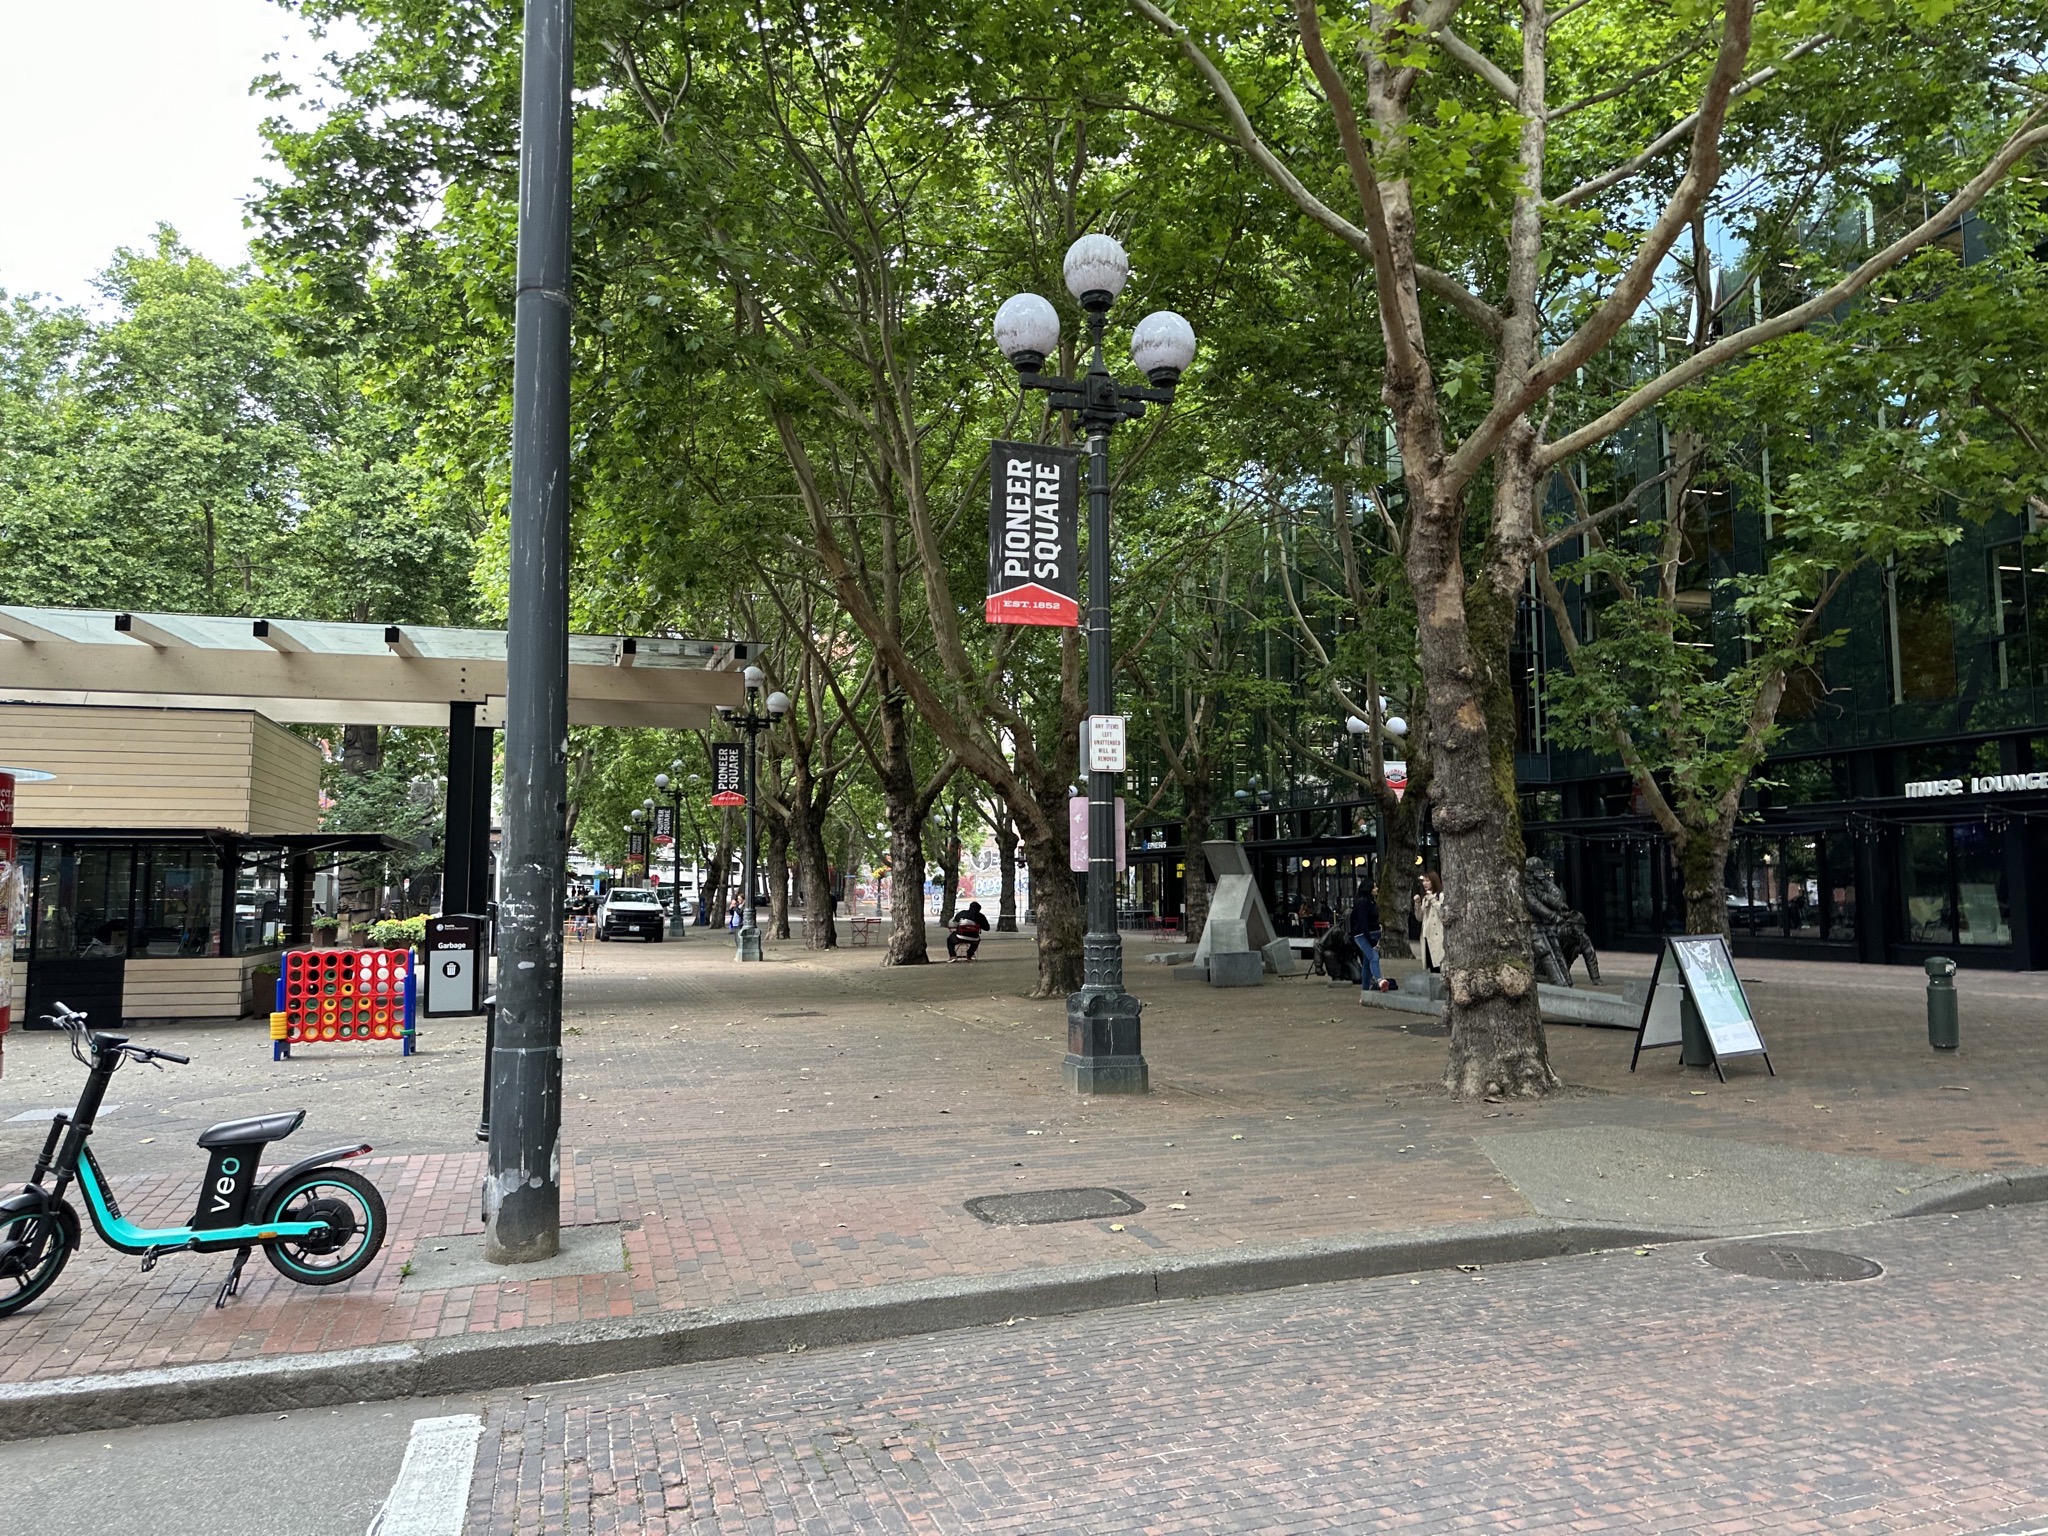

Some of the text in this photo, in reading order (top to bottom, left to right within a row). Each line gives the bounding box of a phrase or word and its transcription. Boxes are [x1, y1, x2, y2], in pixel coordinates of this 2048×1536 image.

[1004, 458, 1032, 578] PIONEER
[1033, 463, 1062, 580] SQUARE
[1033, 601, 1061, 610] 1852
[718, 748, 728, 790] PIONEER
[728, 748, 740, 790] SQUARE
[1971, 771, 2048, 794] LOUNGE
[437, 941, 467, 950] Garbage
[210, 1157, 241, 1213] veo
